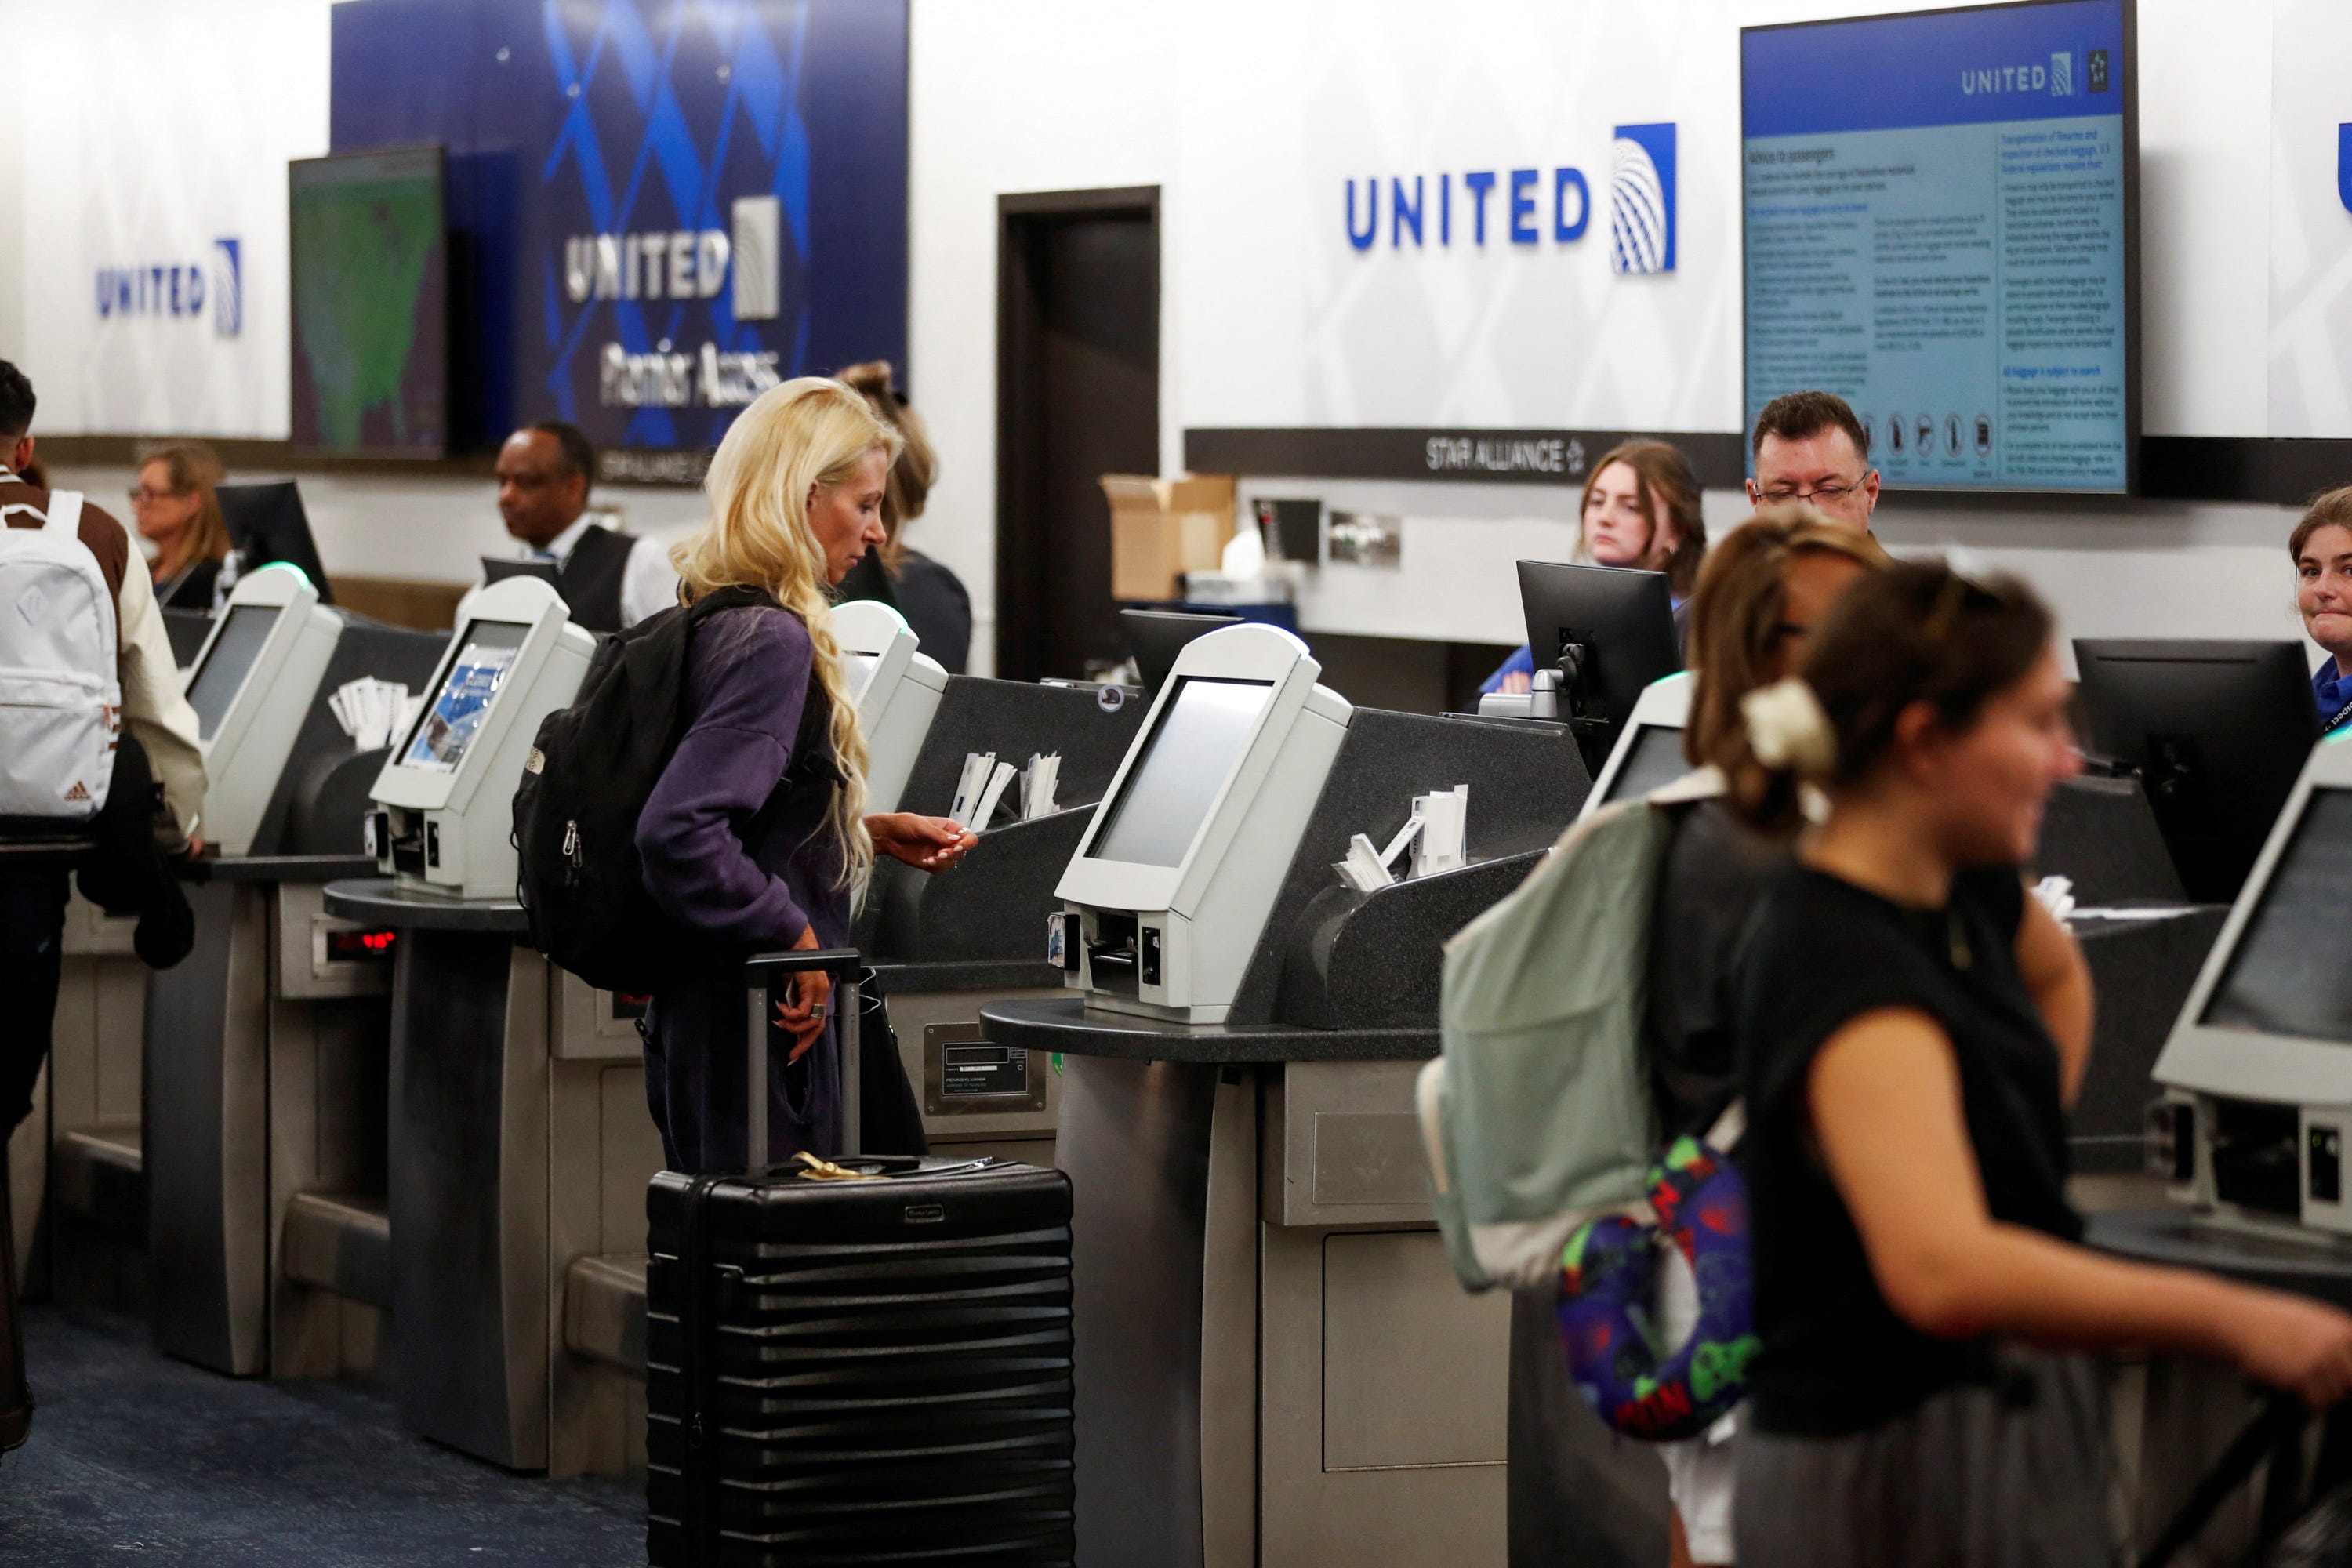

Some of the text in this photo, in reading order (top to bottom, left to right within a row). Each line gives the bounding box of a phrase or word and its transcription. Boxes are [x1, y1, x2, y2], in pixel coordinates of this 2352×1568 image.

[1962, 66, 2045, 95] UNITED
[1346, 168, 1591, 251] UNITED
[95, 264, 205, 318] UNITED
[564, 230, 729, 303] UNITED
[1425, 436, 1565, 472] STAR ALLIANCE
